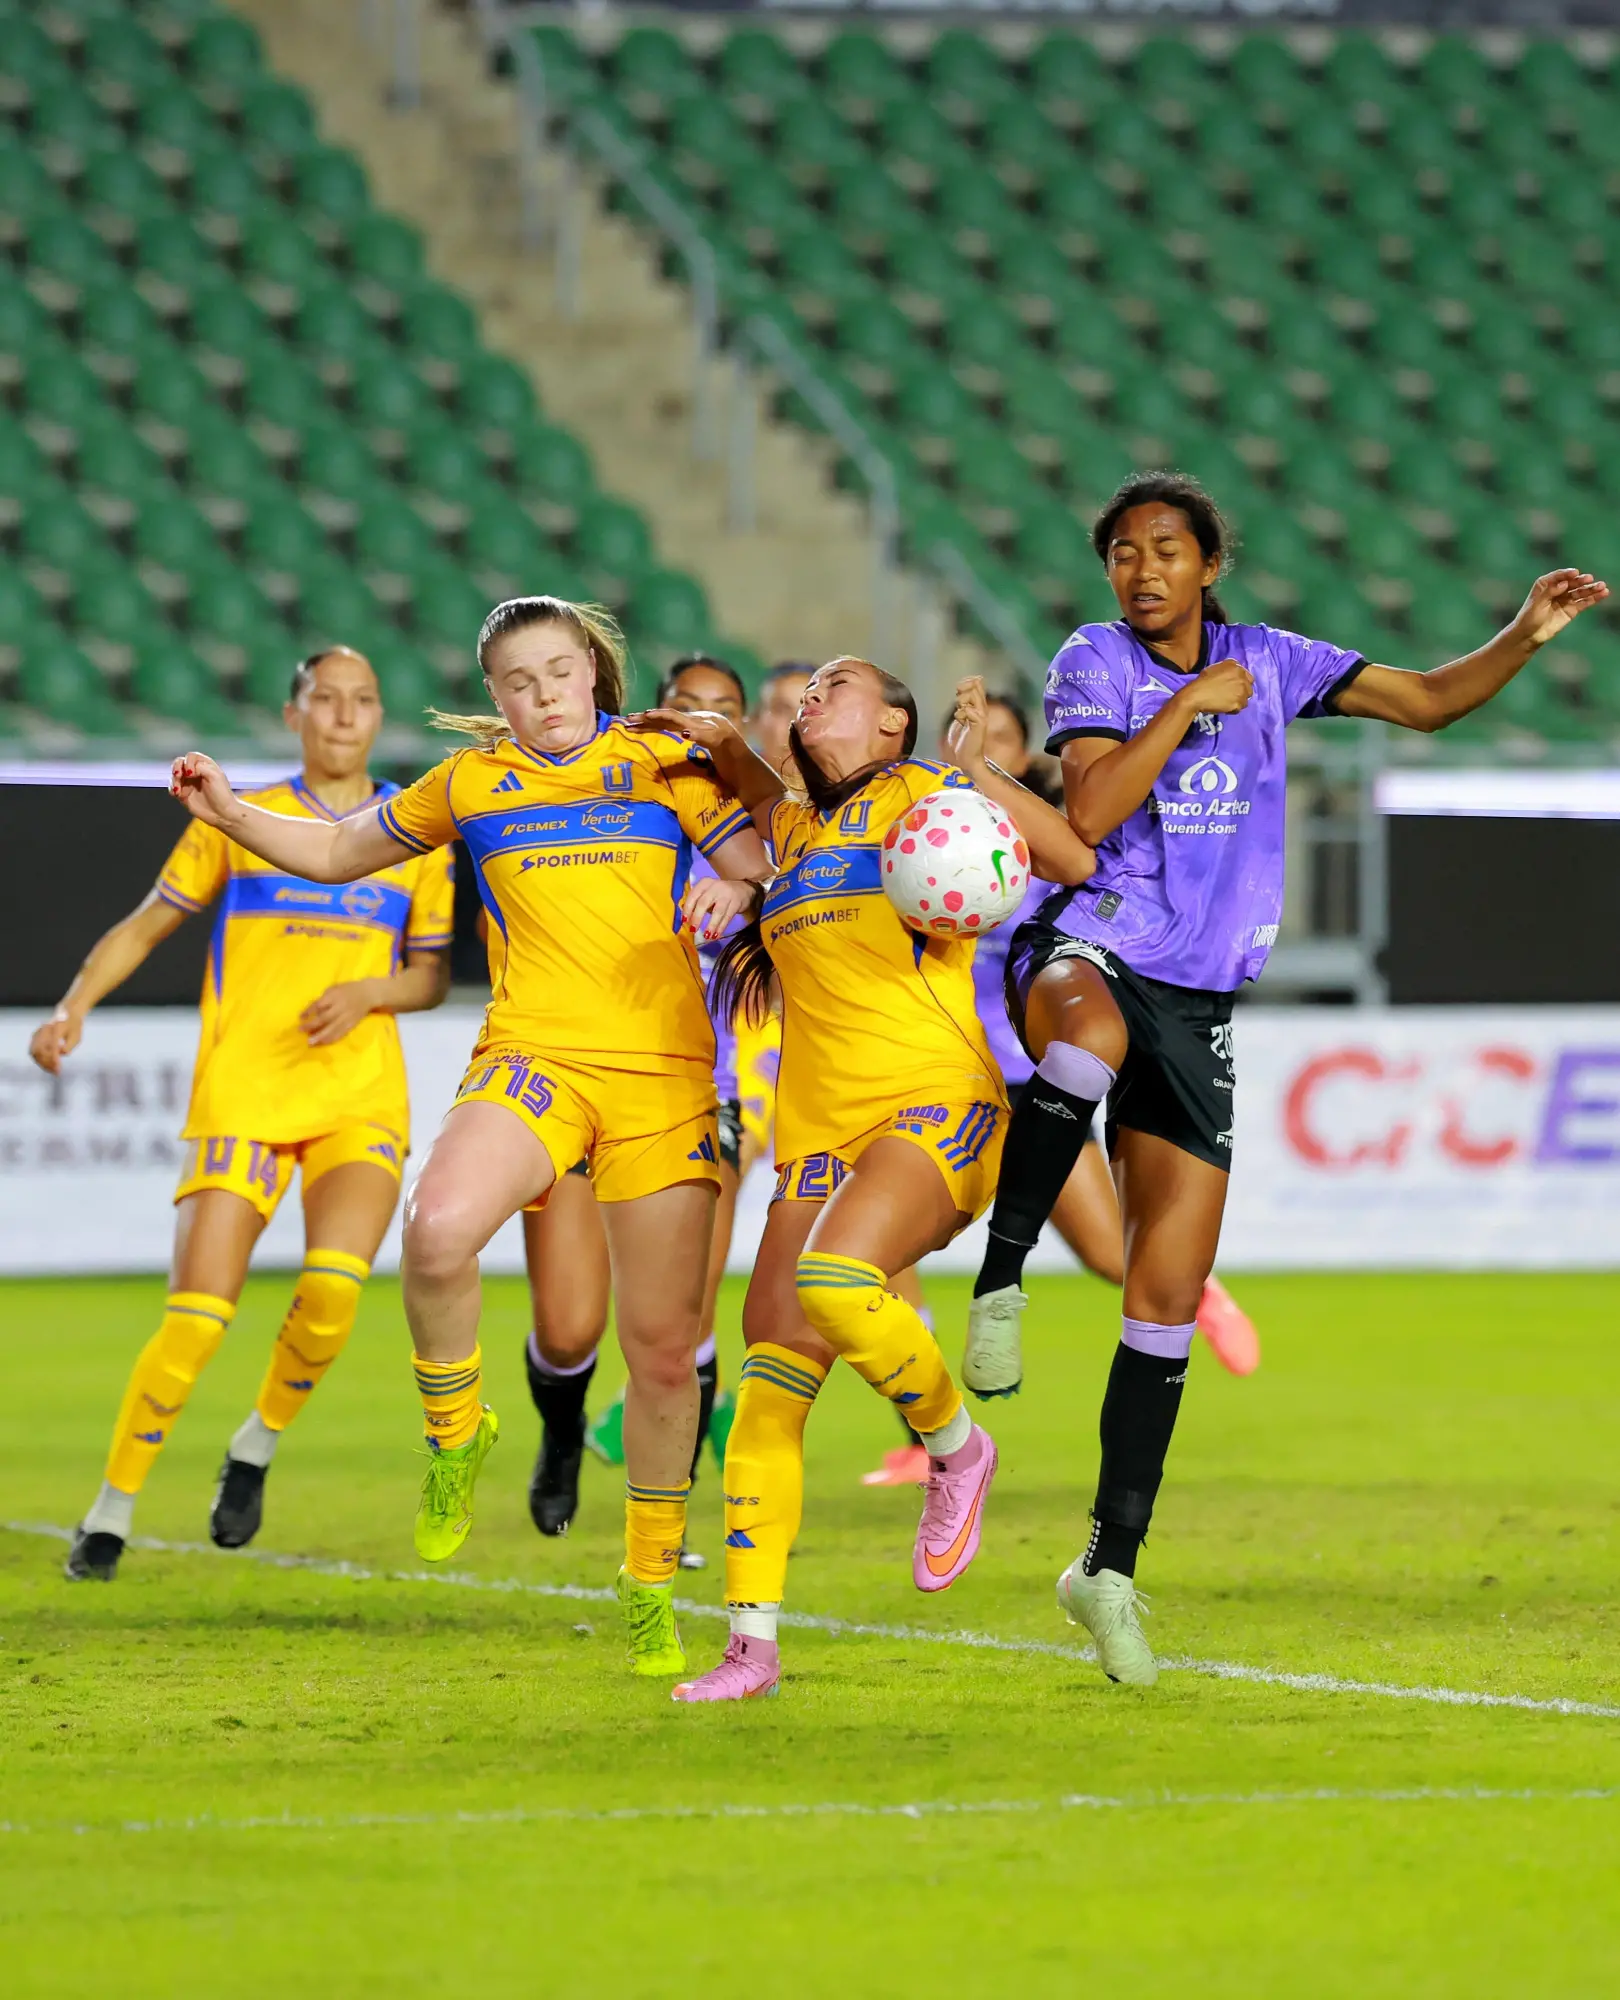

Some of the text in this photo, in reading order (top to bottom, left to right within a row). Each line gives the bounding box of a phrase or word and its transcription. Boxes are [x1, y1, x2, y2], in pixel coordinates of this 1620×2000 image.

[1147, 797, 1203, 816] Banco
[514, 819, 569, 835] CEMEX
[580, 811, 635, 827] Vertua
[1162, 820, 1206, 835] Cuenta
[797, 864, 850, 882] Vertua
[504, 1064, 558, 1119] 15
[247, 1140, 278, 1198] 14
